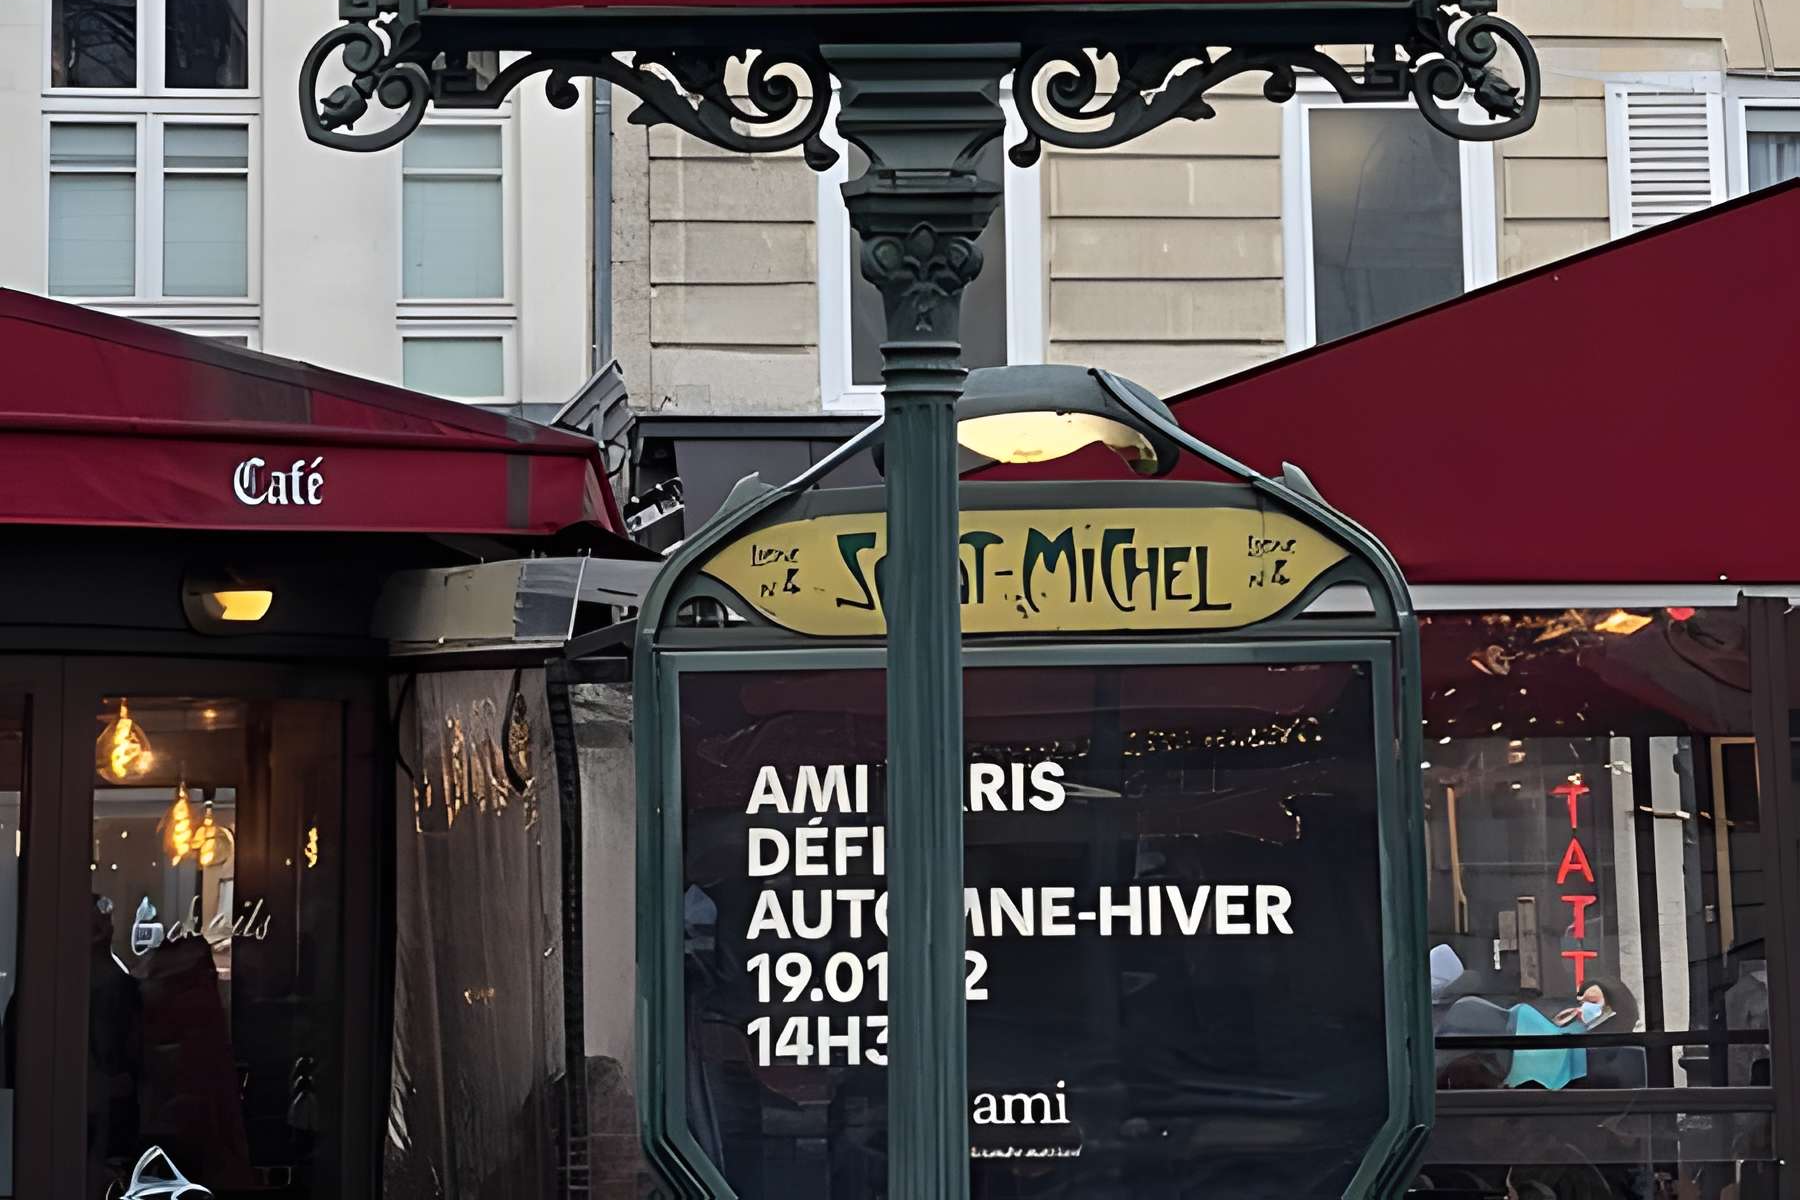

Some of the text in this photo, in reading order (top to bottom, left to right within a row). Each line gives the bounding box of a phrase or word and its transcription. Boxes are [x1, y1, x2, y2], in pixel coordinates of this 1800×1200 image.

[233, 456, 324, 505] Café
[836, 526, 1233, 613] ST-MICHEL
[745, 761, 1066, 814] AMI RIS
[747, 816, 885, 877] DÉFI
[747, 950, 989, 1003] 19.012
[747, 1015, 889, 1067] 14H3
[972, 1080, 1072, 1125] ami
